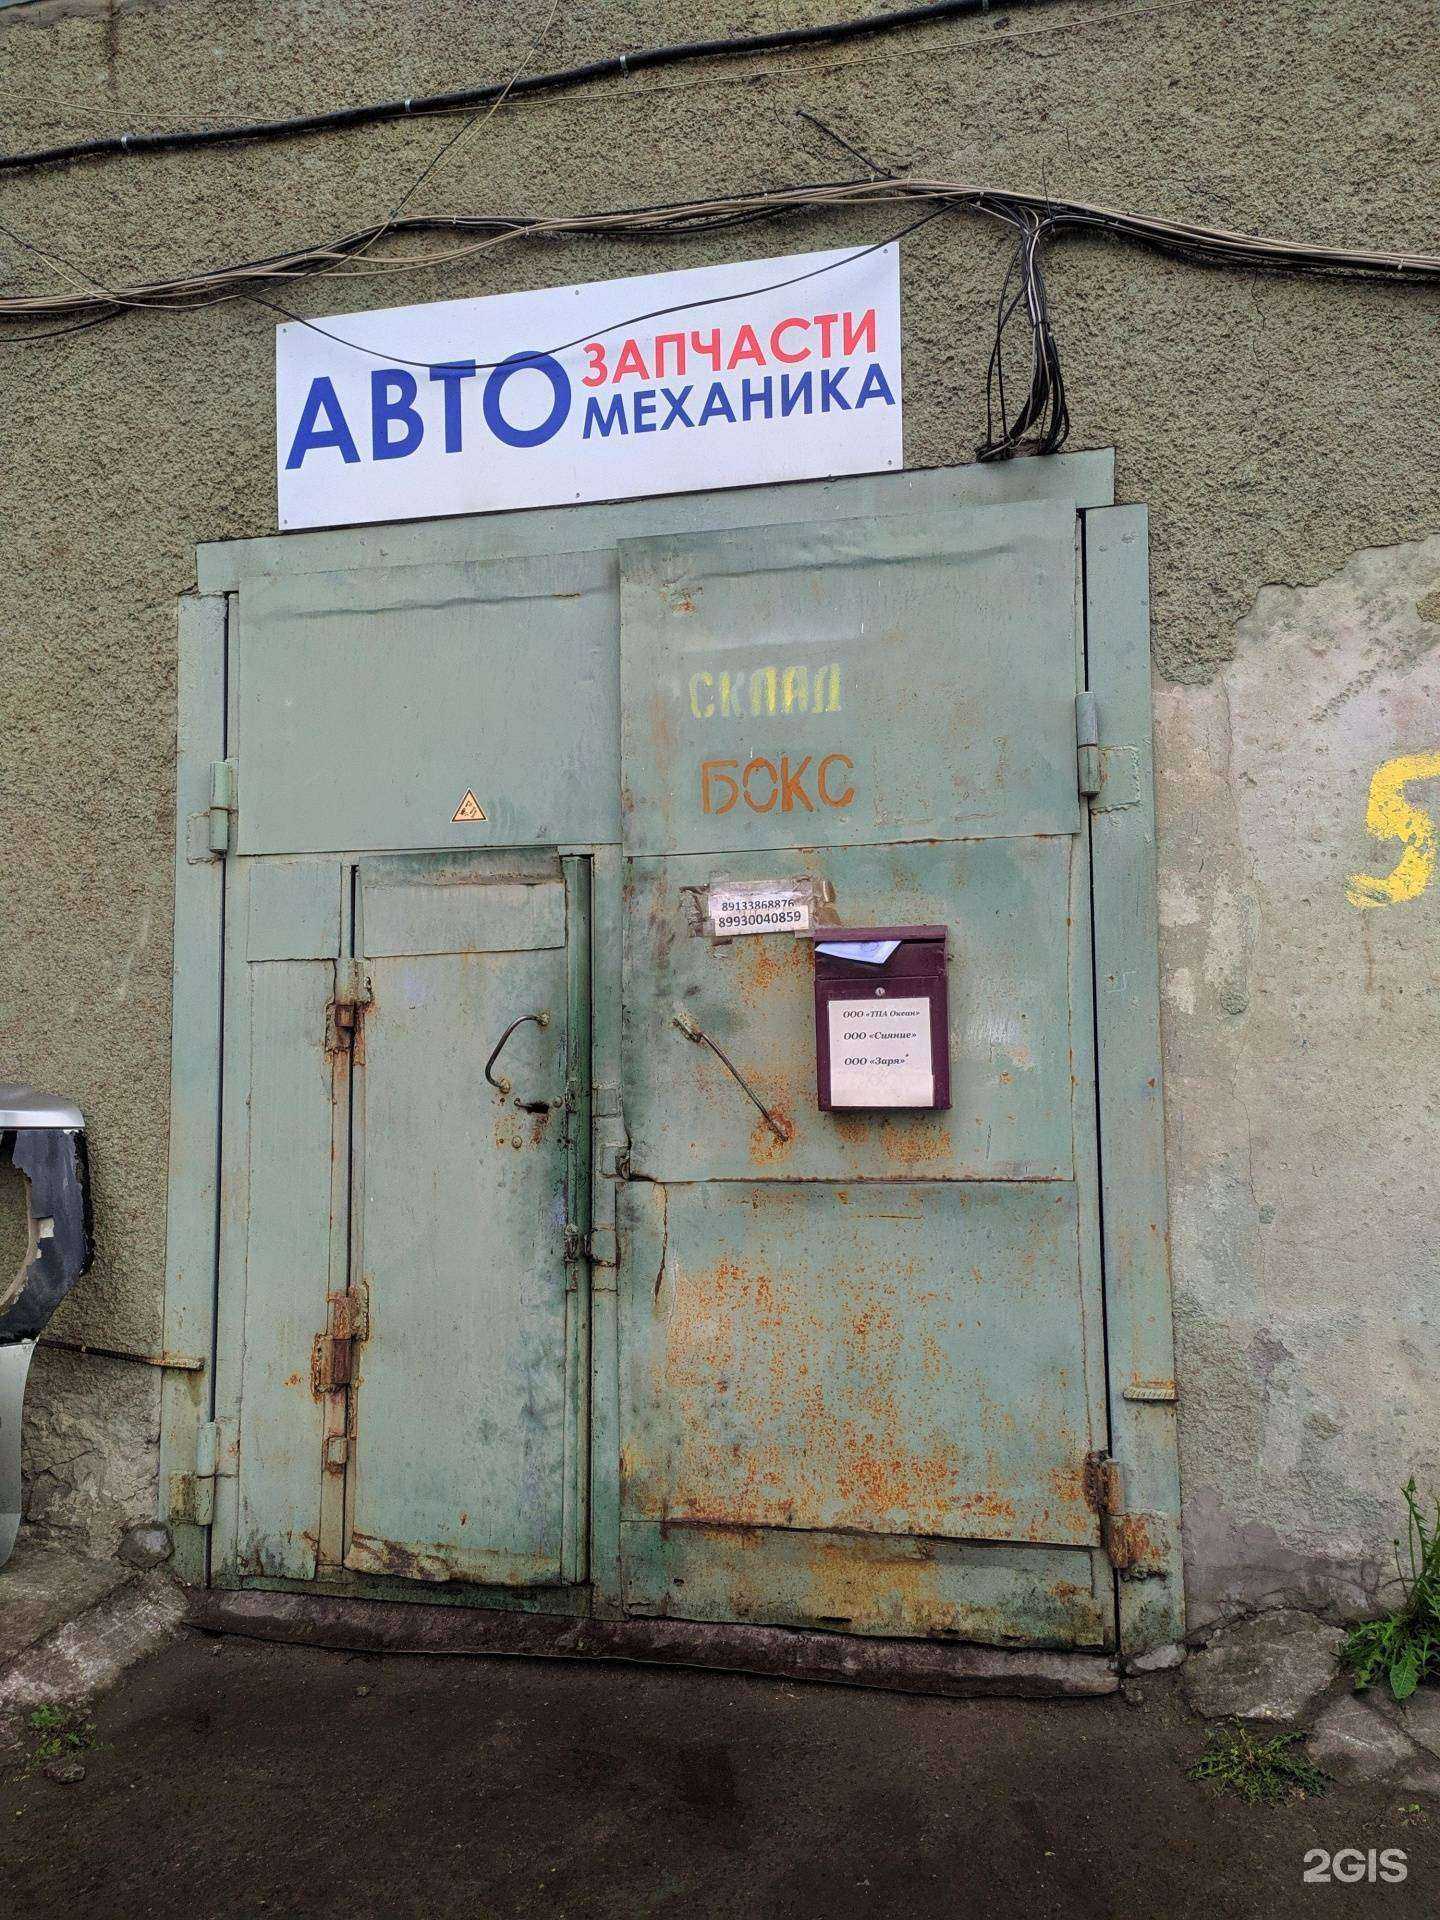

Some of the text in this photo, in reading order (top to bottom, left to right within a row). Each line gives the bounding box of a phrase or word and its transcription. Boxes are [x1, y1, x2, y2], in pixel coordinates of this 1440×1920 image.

[582, 308, 877, 387] ЗАПЧАСТИ
[285, 350, 572, 470] АВТО
[583, 363, 896, 440] МЕХАНИКА
[689, 663, 842, 719] СКЛАД
[701, 754, 856, 815] БОКС
[1344, 752, 1440, 908] 5
[718, 911, 801, 928] 89930040859
[842, 1010, 864, 1018] ООО
[843, 1032, 867, 1040] ООО
[844, 1056, 906, 1067] ООО «Заря»
